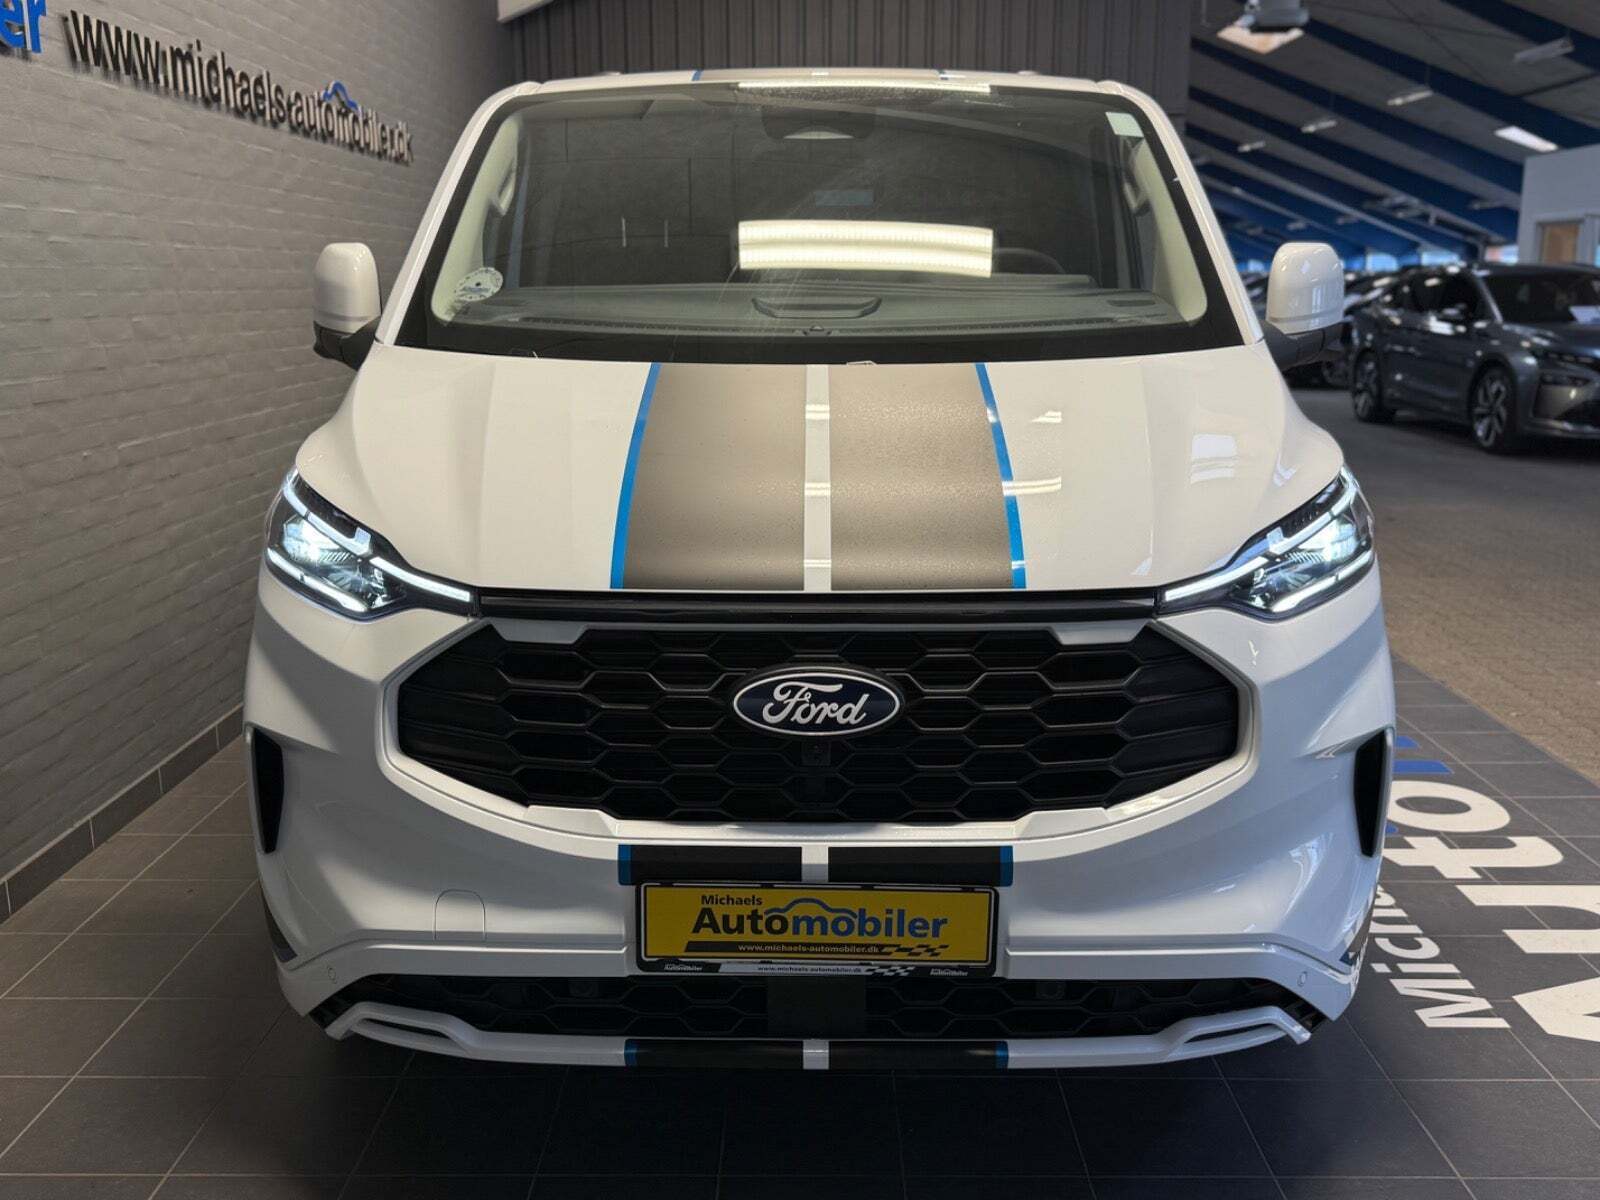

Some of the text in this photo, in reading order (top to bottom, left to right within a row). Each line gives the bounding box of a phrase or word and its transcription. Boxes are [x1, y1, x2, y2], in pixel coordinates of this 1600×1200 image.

[762, 681, 870, 725] Ford
[701, 894, 763, 906] Michaels
[692, 907, 949, 938] Automobiler
[738, 943, 880, 954] www.michaels-automobiler.dk
